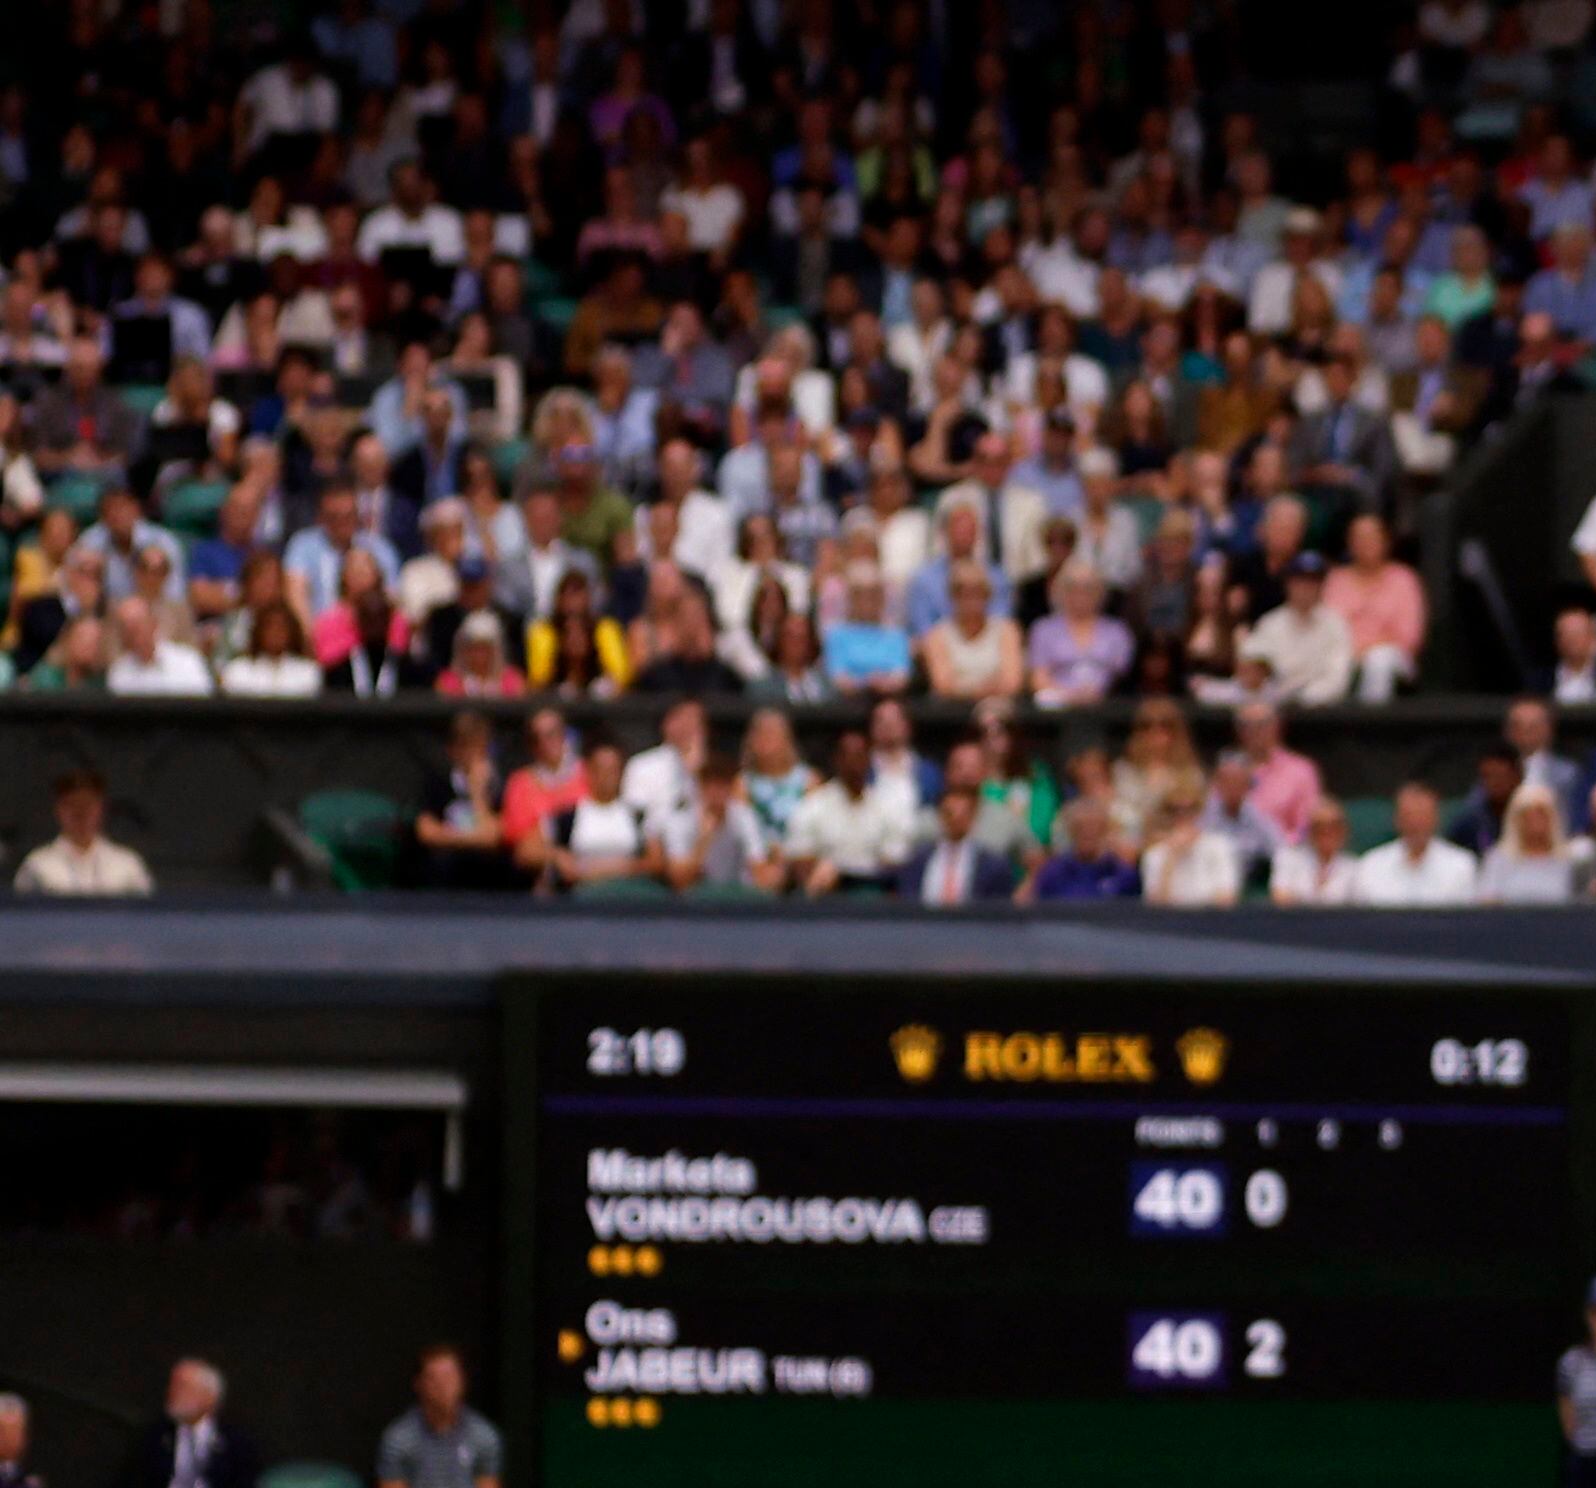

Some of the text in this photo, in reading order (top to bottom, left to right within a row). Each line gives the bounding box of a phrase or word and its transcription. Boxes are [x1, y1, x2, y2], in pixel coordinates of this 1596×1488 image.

[588, 1028, 685, 1074] 2:19
[964, 1032, 1152, 1081] ROLEX
[1431, 1039, 1527, 1085] 0:12
[587, 1148, 757, 1194] Marketa
[585, 1197, 926, 1243] VONDROUSOVA
[1134, 1168, 1287, 1230] 40 0
[585, 1300, 677, 1347] Ons
[585, 1348, 767, 1393] JABEUR
[1132, 1319, 1286, 1379] 40 2
